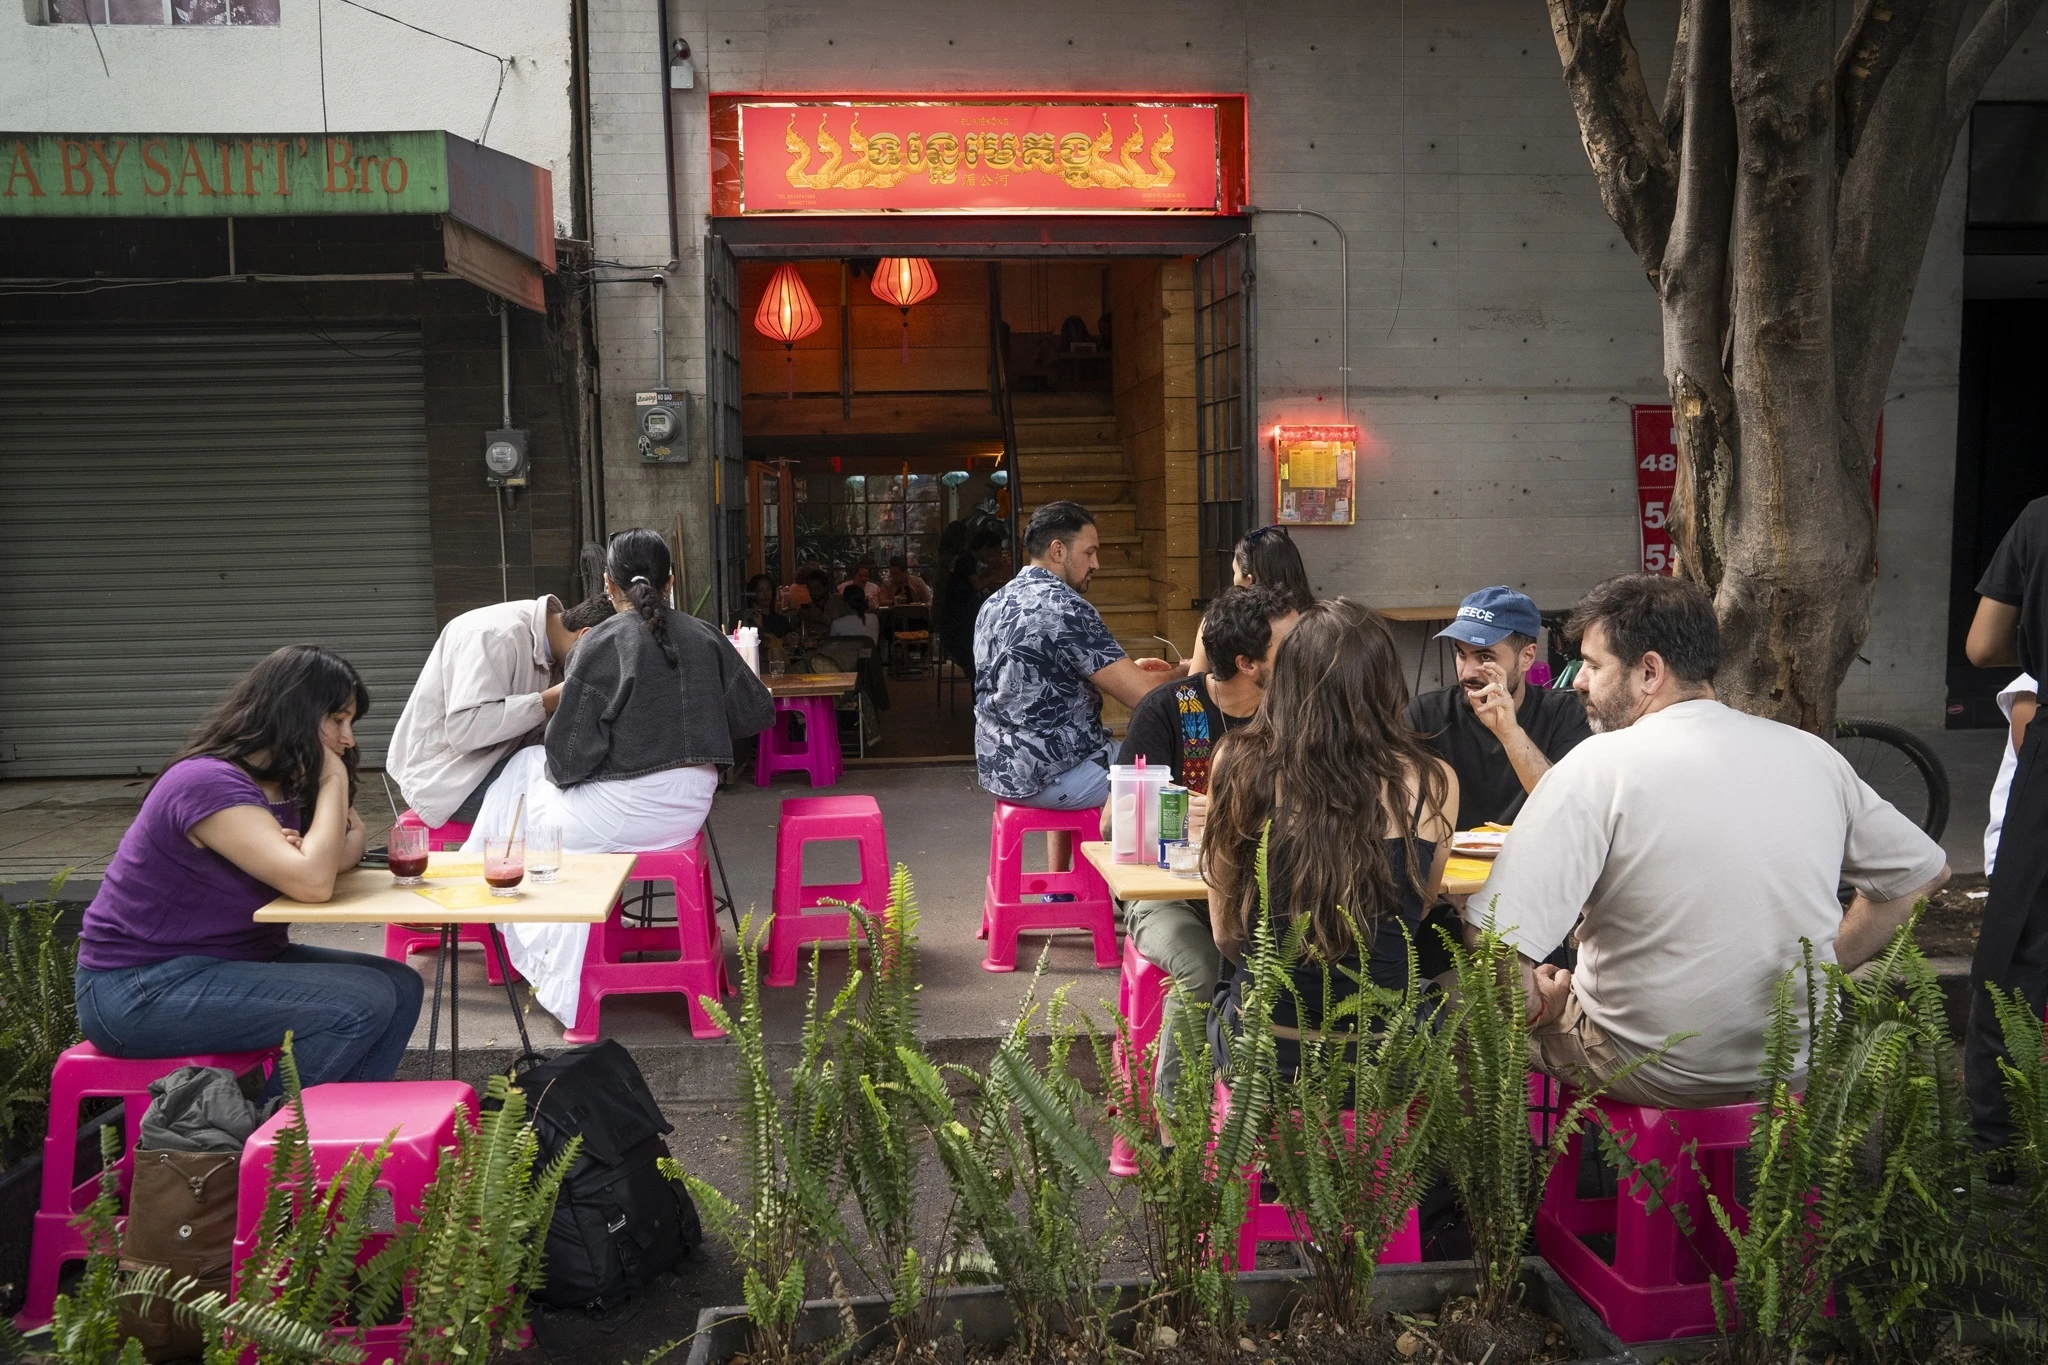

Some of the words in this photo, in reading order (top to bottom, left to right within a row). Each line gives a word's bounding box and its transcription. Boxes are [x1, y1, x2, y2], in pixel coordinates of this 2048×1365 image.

[960, 117, 971, 126] EL
[2, 139, 47, 197] A
[55, 141, 128, 196] BY
[321, 138, 410, 195] Bro
